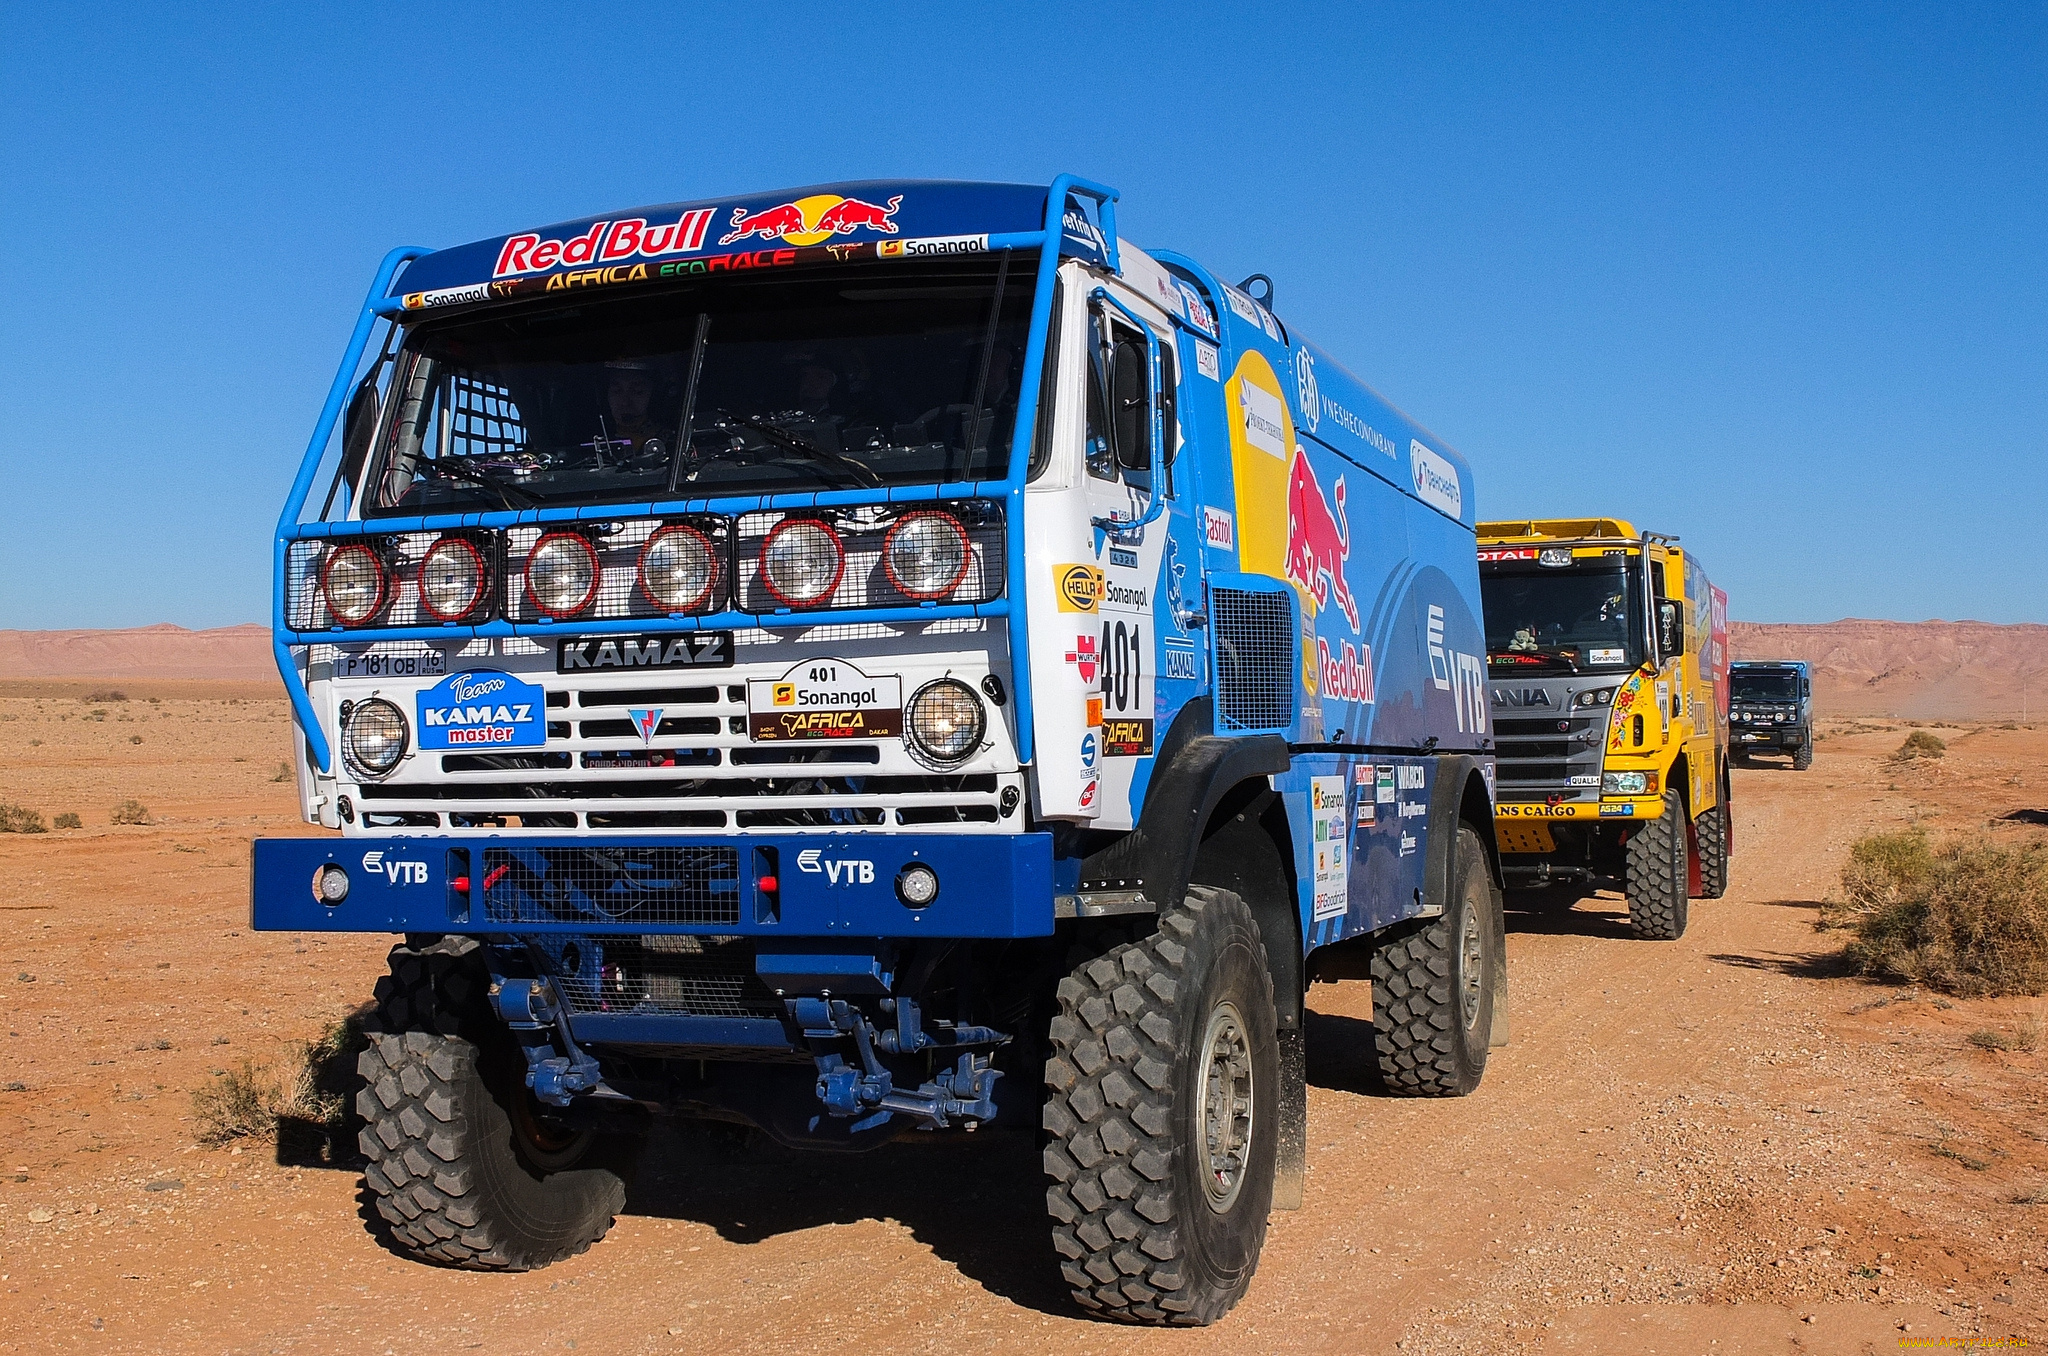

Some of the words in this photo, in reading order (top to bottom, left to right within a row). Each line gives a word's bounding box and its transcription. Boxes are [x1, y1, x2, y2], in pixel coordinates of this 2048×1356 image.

[492, 221, 610, 278] Red
[600, 208, 718, 261] Bull
[905, 236, 987, 256] Sonangol
[545, 264, 649, 291] AFRICA
[660, 260, 707, 277] ECO
[708, 249, 796, 273] RACE
[424, 286, 488, 307] Sonangol
[1321, 394, 1397, 461] VNESHECONOMBANK
[1204, 511, 1232, 545] Castrol
[1067, 581, 1096, 597] HELLA
[1106, 580, 1148, 612] Sonangol
[422, 651, 440, 667] 16
[564, 636, 725, 669] KAMAZ
[1591, 655, 1622, 663] Sonangol
[809, 667, 837, 682] 401
[1100, 620, 1141, 712] 401
[1165, 650, 1196, 679] KAMAZ
[1317, 635, 1349, 701] Red
[1346, 642, 1375, 705] Bull
[451, 673, 505, 703] Team
[798, 688, 877, 708] Sonangol
[1448, 649, 1487, 734] VTB
[1490, 688, 1551, 706] ANIA
[425, 704, 533, 726] KAMAZ
[792, 712, 864, 730] AFRICA
[448, 726, 515, 743] master
[824, 728, 853, 737] RACE
[1108, 723, 1143, 743] AFRICA
[1397, 765, 1425, 789] WABCO
[1321, 790, 1345, 813] Sonangol
[1523, 806, 1576, 816] CARGO
[1600, 805, 1622, 813] AS24
[386, 861, 428, 884] VTB
[824, 860, 875, 884] VTB
[1316, 889, 1346, 910] BFGoodrich
